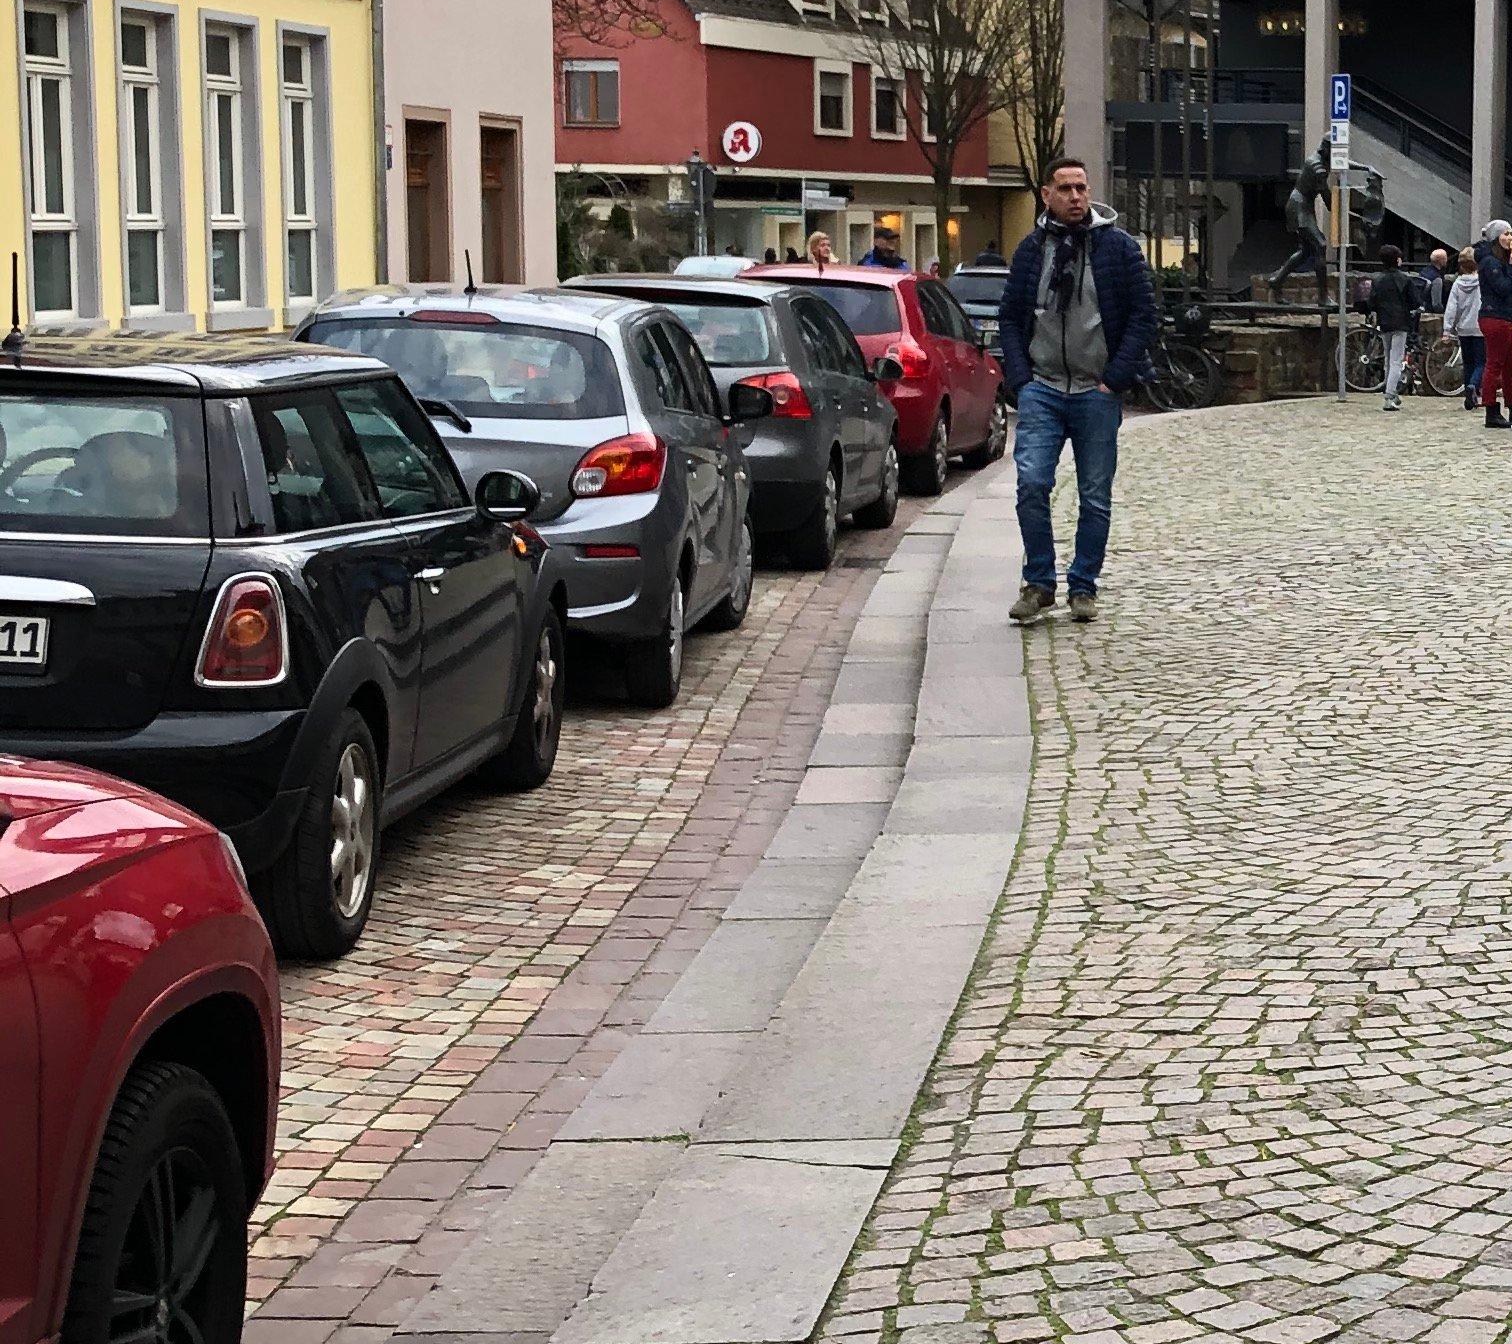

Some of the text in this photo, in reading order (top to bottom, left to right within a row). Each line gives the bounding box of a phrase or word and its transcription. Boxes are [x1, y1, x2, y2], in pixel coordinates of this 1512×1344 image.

[1334, 80, 1347, 115] P
[729, 128, 751, 154] A
[0, 621, 40, 658] 11
